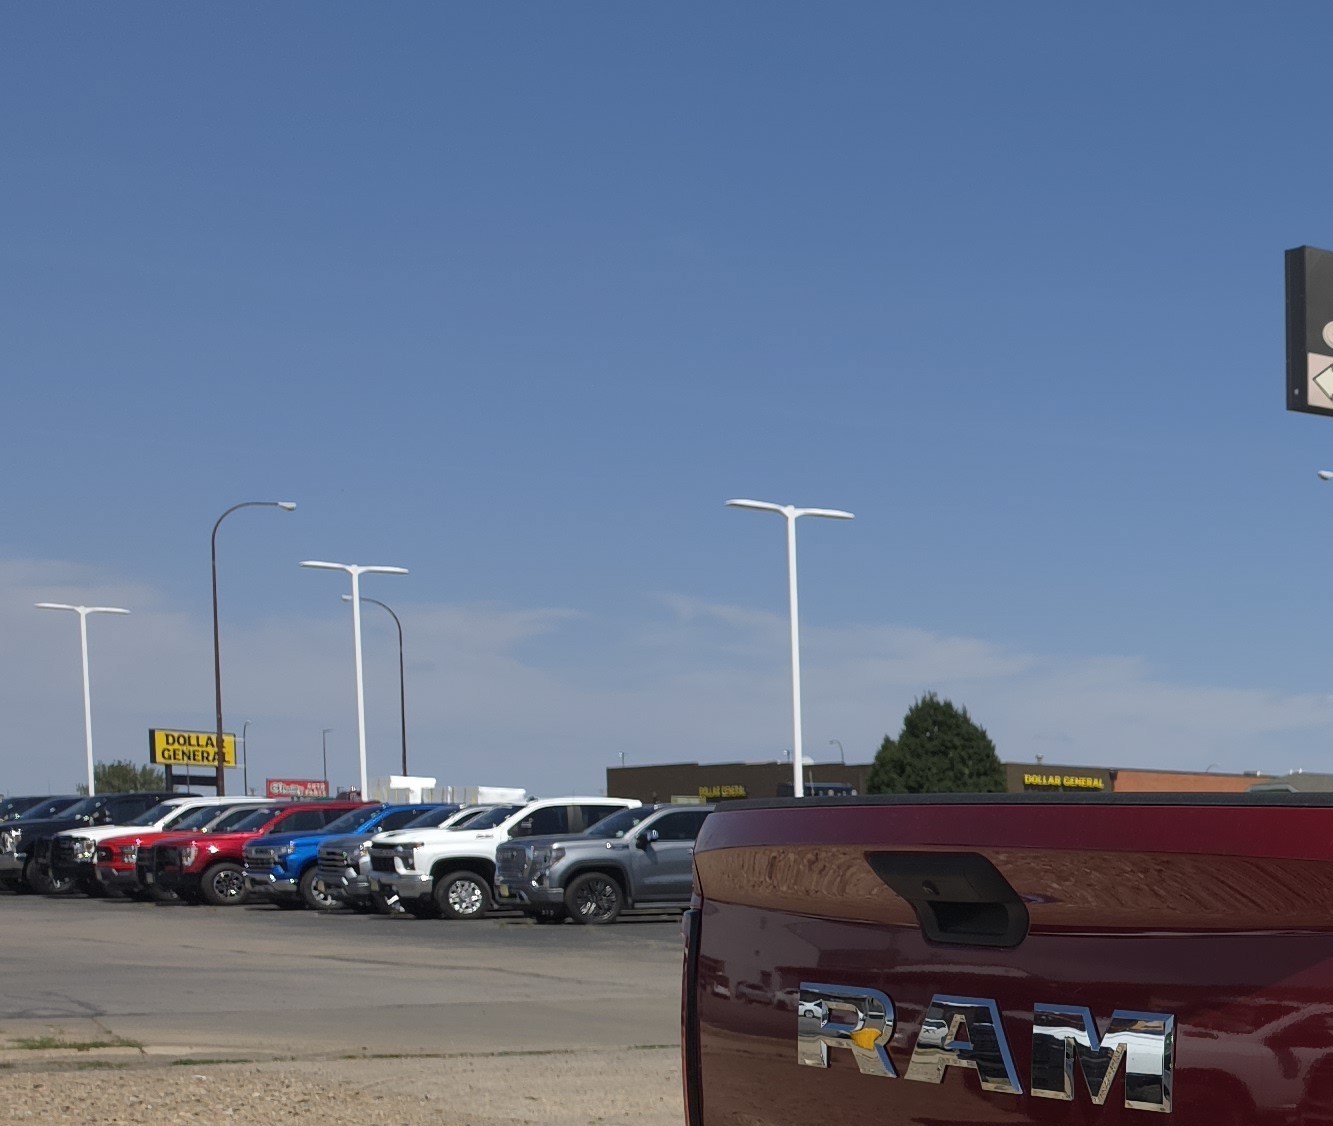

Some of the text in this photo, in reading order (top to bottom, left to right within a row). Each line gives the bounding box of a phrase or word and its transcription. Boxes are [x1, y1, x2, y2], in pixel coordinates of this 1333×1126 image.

[1024, 773, 1104, 789] DOLLAR GENERAL
[797, 981, 1177, 1114] RAM
